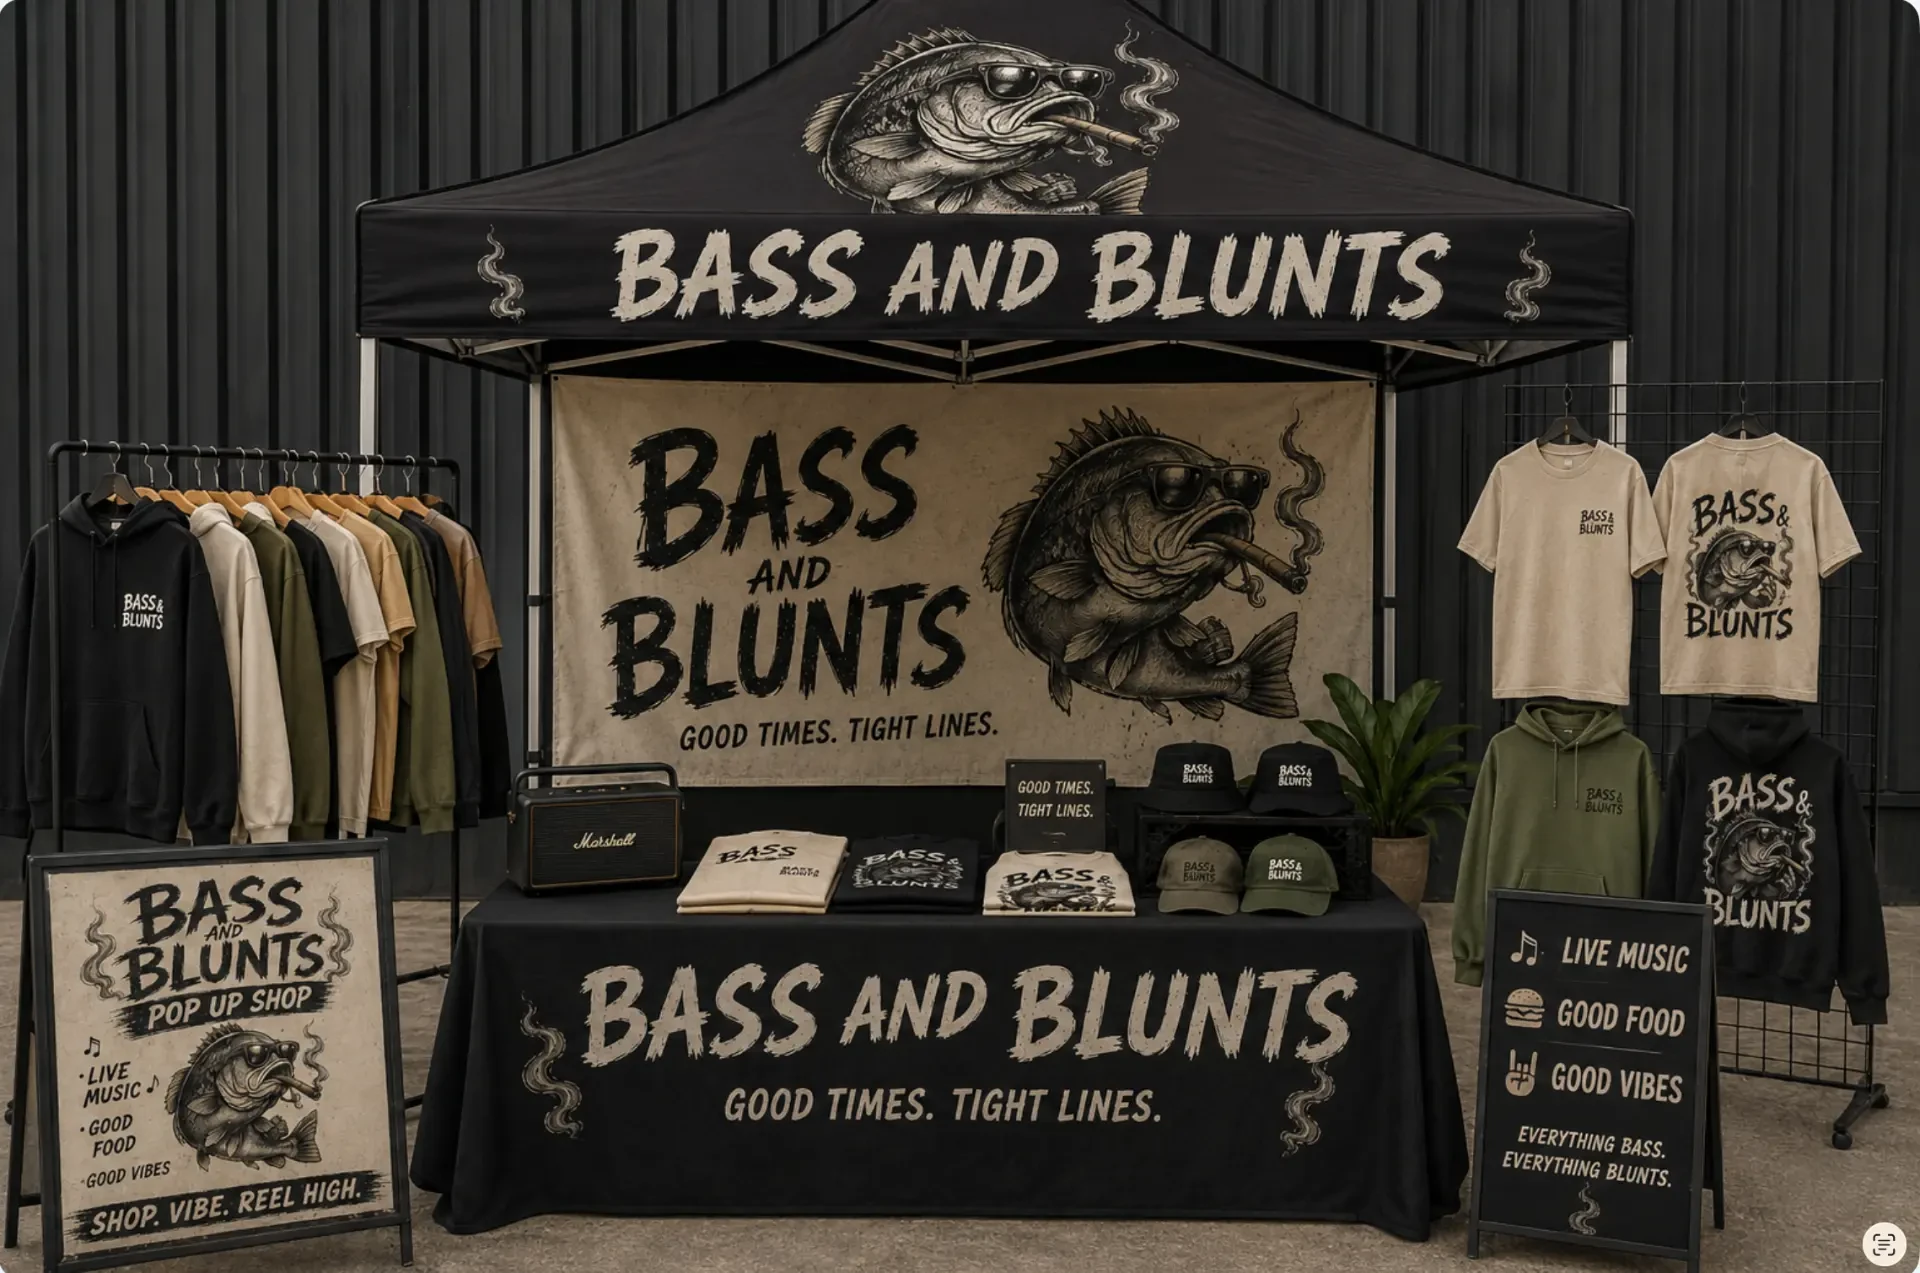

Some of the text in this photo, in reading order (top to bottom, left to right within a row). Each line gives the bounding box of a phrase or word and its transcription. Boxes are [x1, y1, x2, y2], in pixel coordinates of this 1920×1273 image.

[609, 227, 1452, 323] BASS AND BLUNTS
[630, 424, 920, 571] BASS
[1579, 523, 1614, 536] BLUNTS
[748, 556, 831, 595] AND
[122, 612, 163, 630] BLUNTS
[1684, 602, 1793, 641] BLUNTS
[600, 582, 970, 719] BLUNTS
[679, 711, 998, 751] GOOD TIMES. TIGHT LINES.
[1017, 781, 1094, 795] GOOD TIMES.
[1278, 775, 1312, 787] BLUNTS
[1018, 803, 1094, 818] TIGHT LINES.
[1585, 801, 1623, 815] BLUNTS
[573, 832, 637, 849] Marshall
[716, 844, 797, 864] BASS
[1267, 869, 1302, 881] BLUNTS
[123, 875, 303, 946] BASS
[1702, 886, 1812, 934] BLUNTS
[204, 923, 243, 941] AND
[113, 931, 325, 1000] BLUNTS
[1562, 936, 1690, 974] LIVE MUSIC
[148, 986, 313, 1030] POP UP SHOP
[580, 962, 1360, 1068] BASS AND BLUNTS
[1557, 998, 1685, 1037] GOOD FOOD
[87, 1061, 131, 1086] LIVE
[1551, 1062, 1683, 1104] GOOD VIBES
[83, 1081, 141, 1108] MUSIC
[723, 1087, 1163, 1123] GOOD TIMES. TIGHT LINES.
[88, 1114, 133, 1137] GOOD
[1518, 1125, 1666, 1158] EVERYTHING BASS.
[92, 1135, 136, 1158] FOOD
[86, 1161, 171, 1189] GOOD VIBES
[1502, 1151, 1672, 1187] EVERYTHING BLUNTS.
[90, 1178, 362, 1236] SHOP. VIBE. REEL HIGH.
